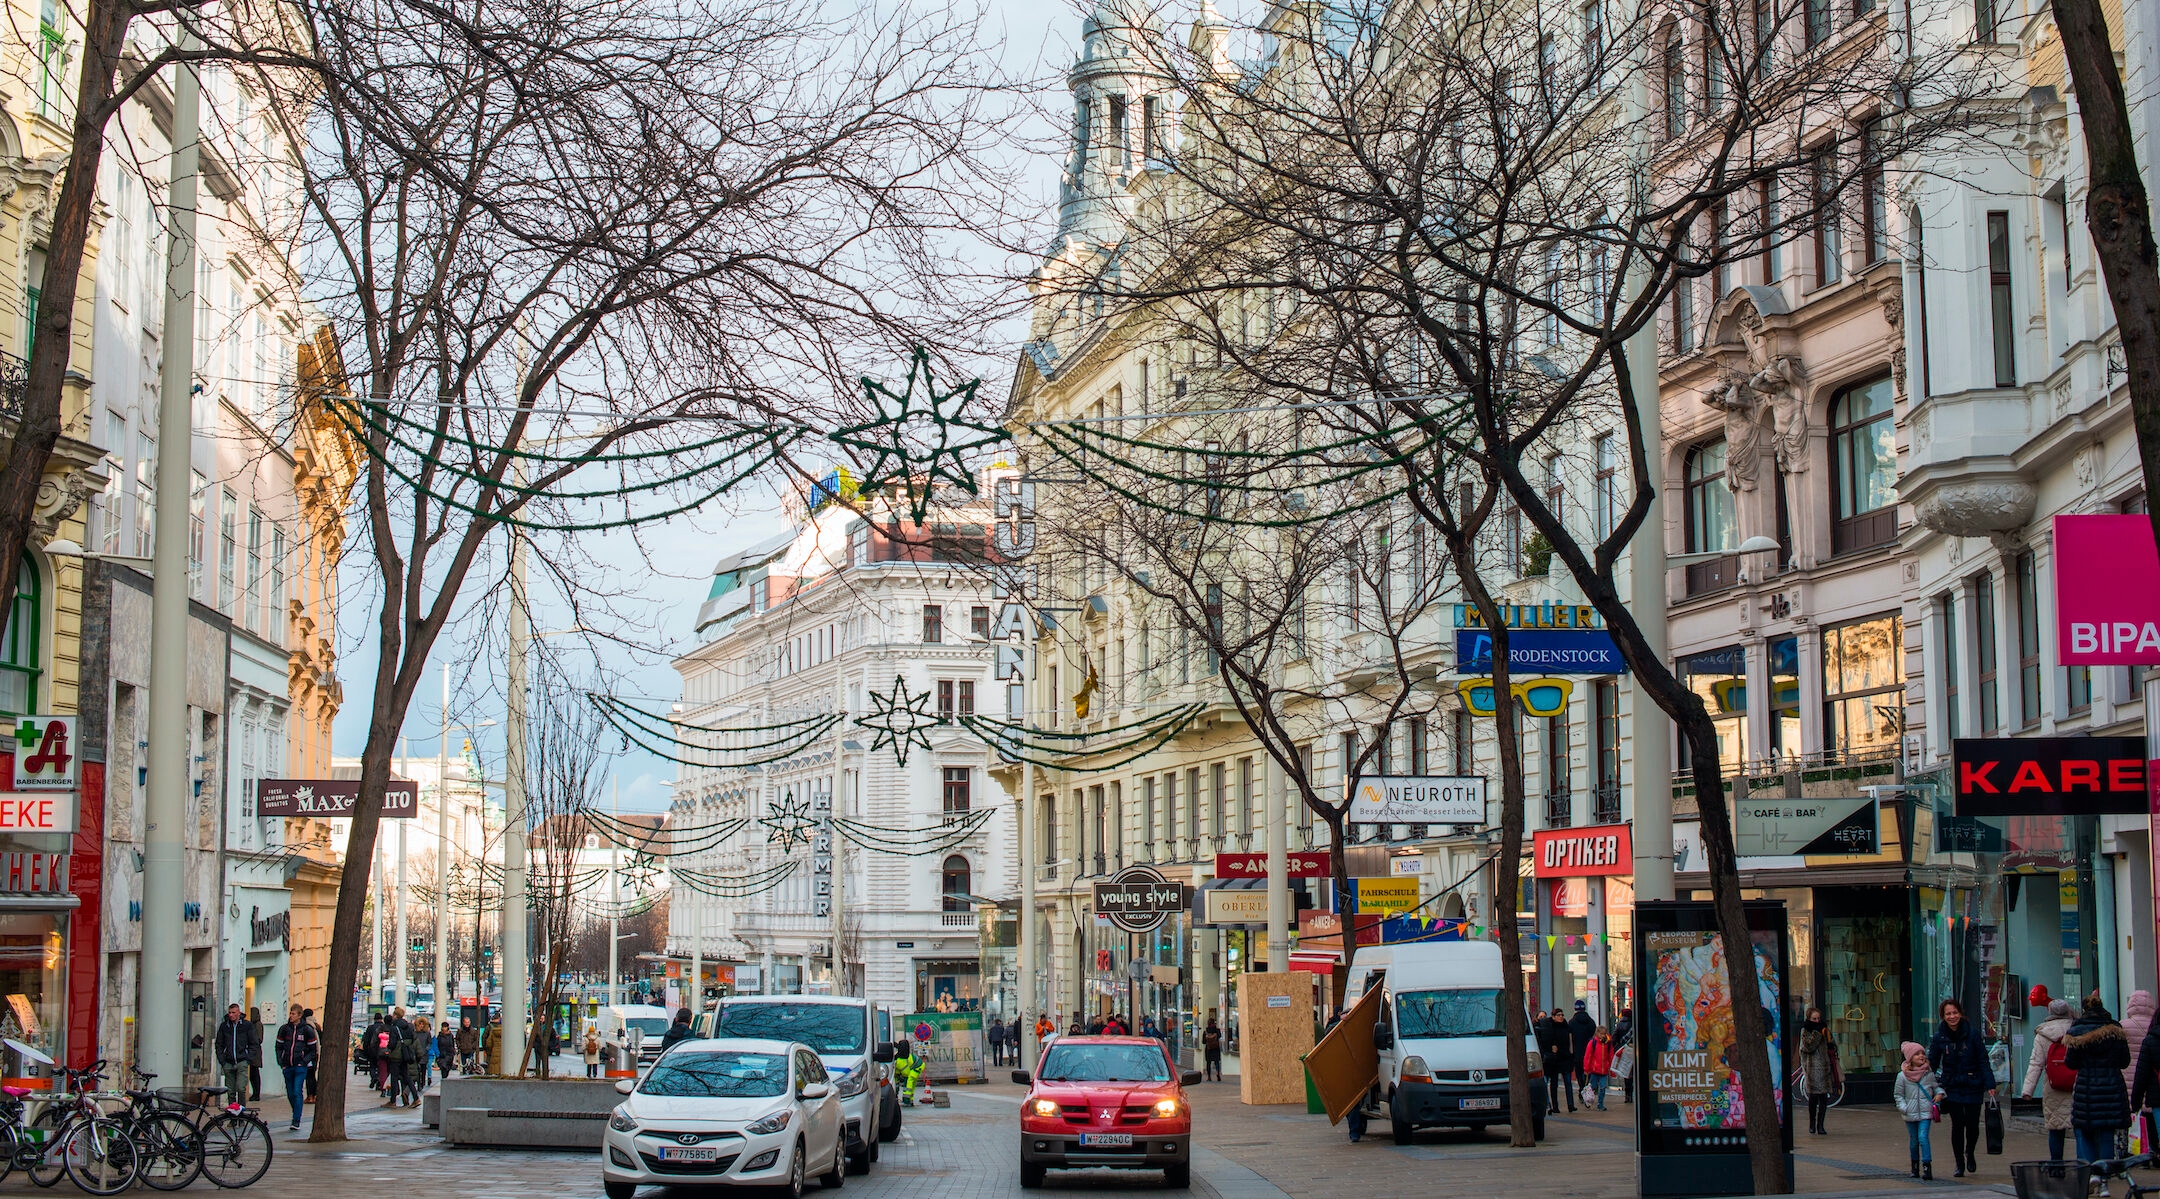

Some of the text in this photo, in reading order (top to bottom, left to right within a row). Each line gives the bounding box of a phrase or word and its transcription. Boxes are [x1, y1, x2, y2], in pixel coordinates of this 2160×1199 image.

[2070, 621, 2160, 654] BIPA
[1509, 649, 1611, 663] RODENSTOCK
[1960, 759, 2146, 794] KARE
[1389, 786, 1477, 802] NEUROTH
[1423, 807, 1450, 815] Besser
[1754, 806, 1817, 818] CAFÉ BAR
[1544, 835, 1619, 868] OPTIKER
[0, 853, 78, 892] HEKE
[1245, 858, 1302, 873] ANER
[1100, 888, 1179, 907] young style
[1360, 888, 1418, 897] FAHRSCHULE
[1361, 899, 1410, 908] MARIAHILF
[1660, 930, 1697, 938] LEOPOLD
[1660, 937, 1697, 945] MUSEUM
[1663, 1052, 1708, 1069] KLIMT
[1652, 1072, 1715, 1089] SCHIELE
[1661, 1093, 1708, 1101] MASTERPIECES
